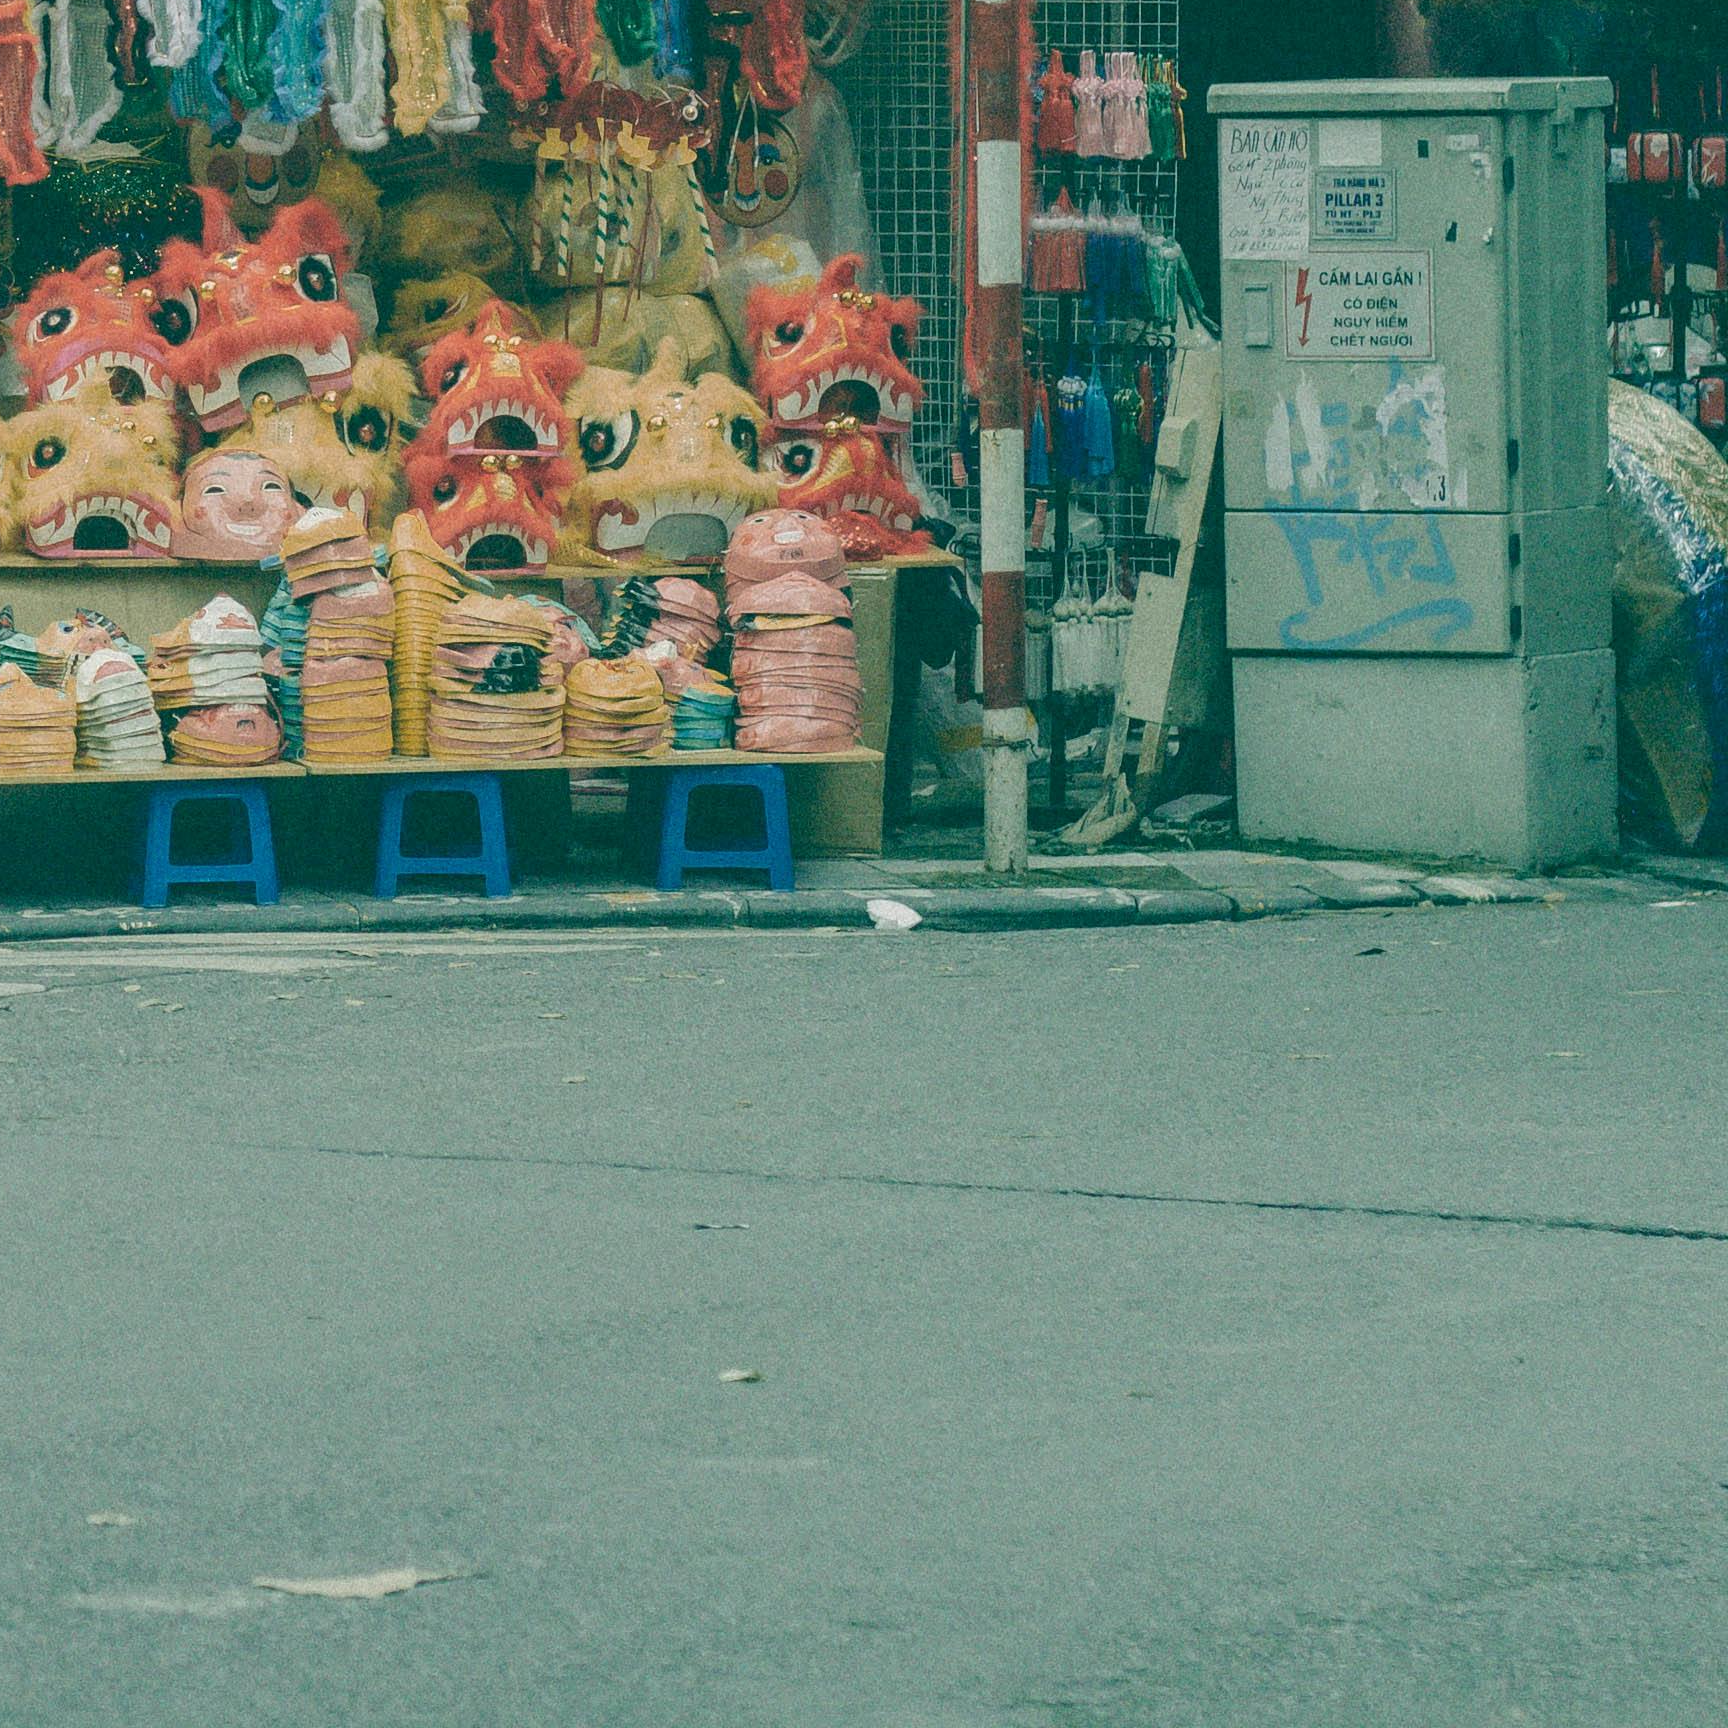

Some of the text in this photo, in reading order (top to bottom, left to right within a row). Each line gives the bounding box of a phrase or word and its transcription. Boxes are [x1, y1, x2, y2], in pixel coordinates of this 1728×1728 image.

[1325, 193, 1384, 207] PILLAR 3
[1343, 295, 1363, 309] CÓ
[1334, 316, 1371, 328] NGUY
